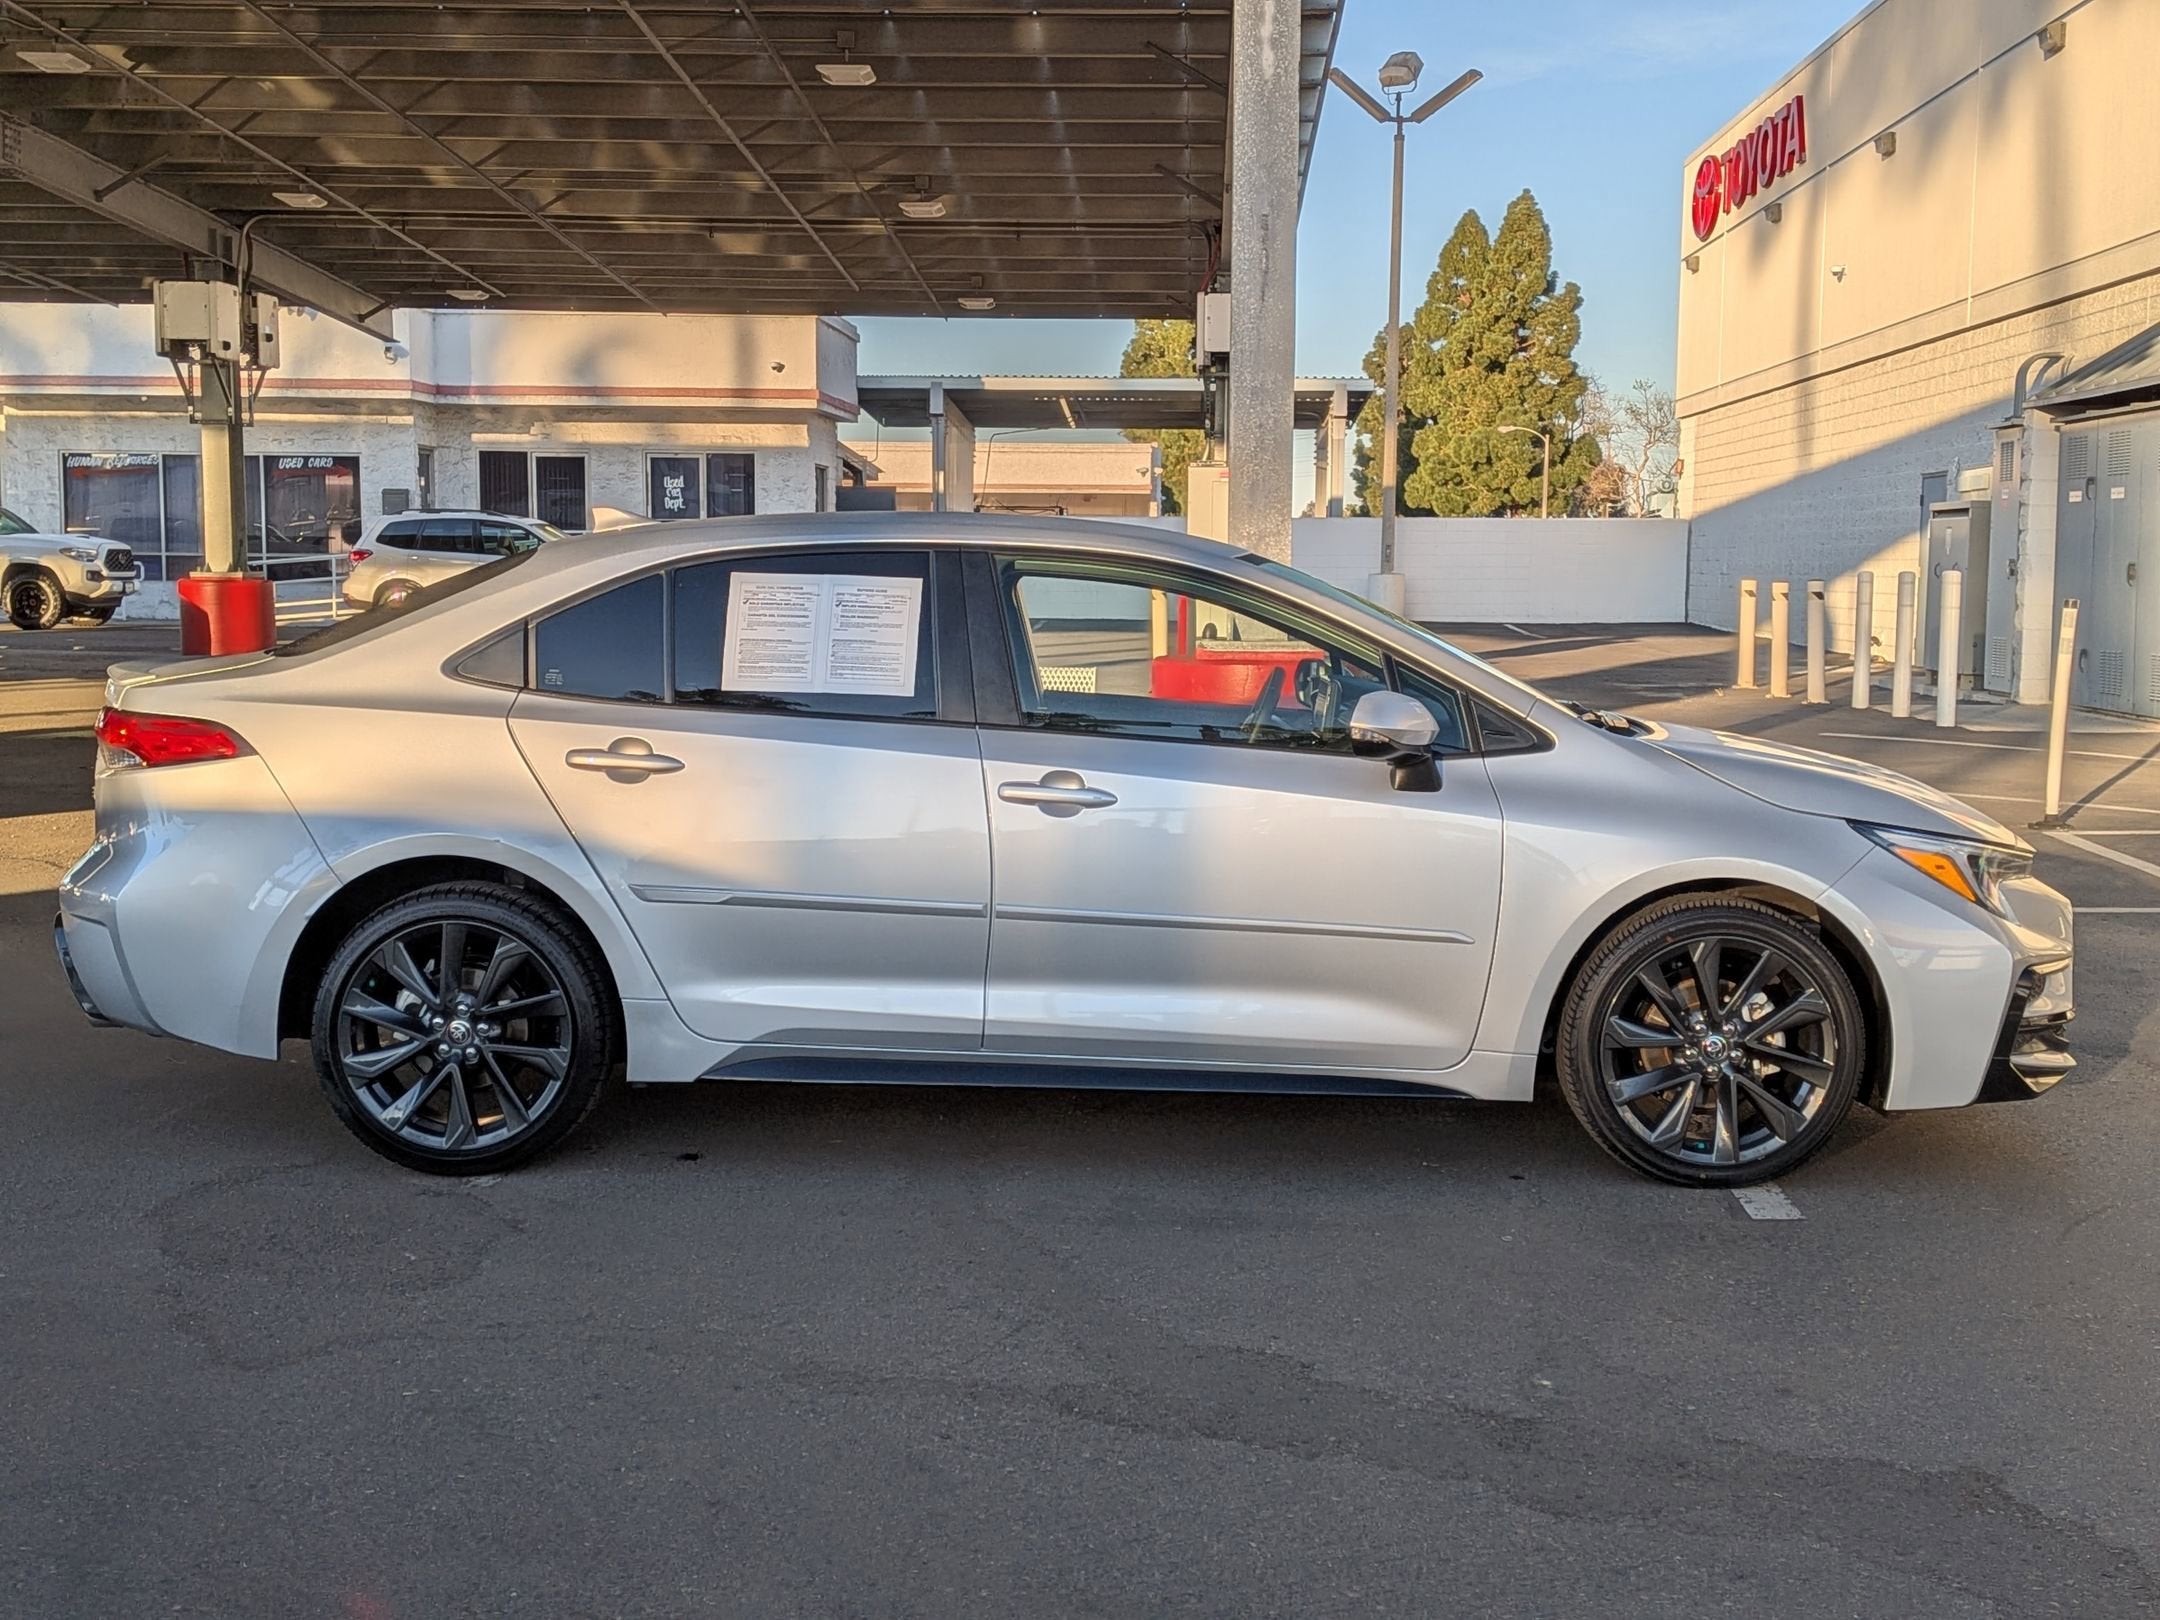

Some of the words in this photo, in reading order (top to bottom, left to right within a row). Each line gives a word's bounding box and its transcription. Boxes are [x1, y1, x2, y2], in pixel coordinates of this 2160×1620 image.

[1720, 95, 1806, 215] TOYOTA
[66, 455, 103, 468] HUMAN
[278, 457, 304, 470] USED
